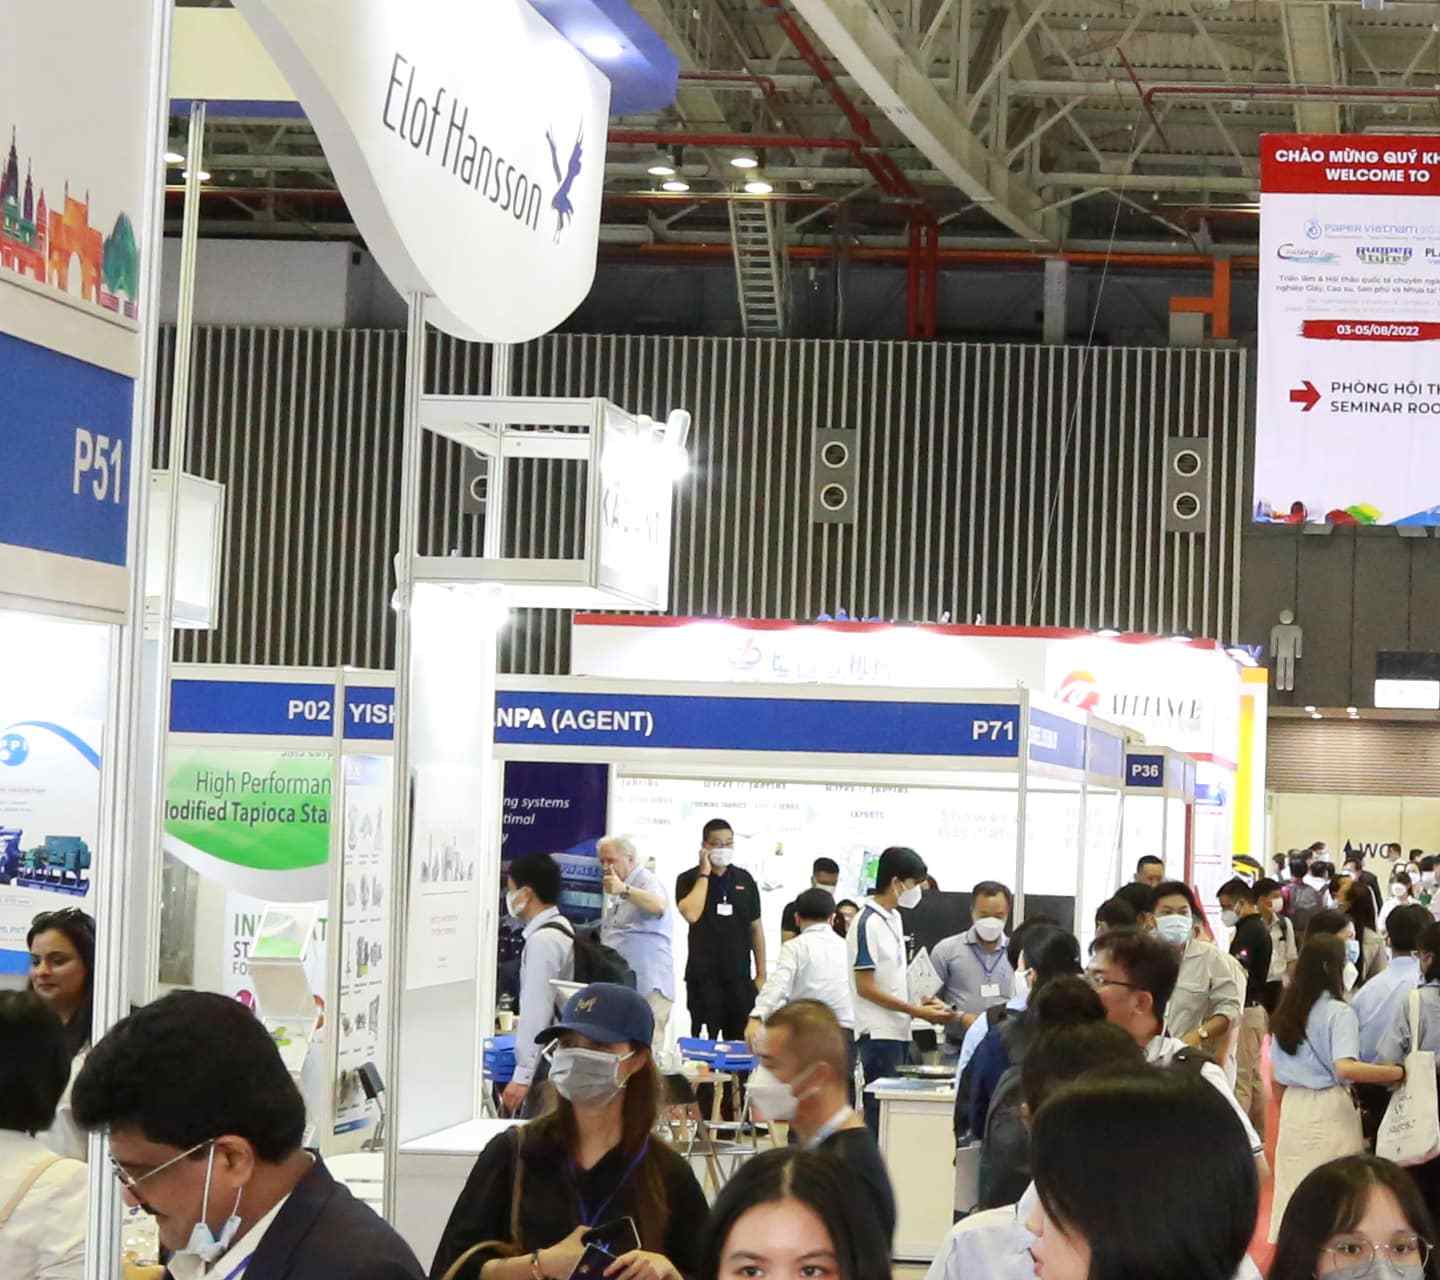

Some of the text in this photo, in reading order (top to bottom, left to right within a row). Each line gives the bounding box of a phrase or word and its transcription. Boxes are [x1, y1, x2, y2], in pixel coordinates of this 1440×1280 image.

[382, 53, 542, 232] Elof Hansson
[1326, 169, 1429, 183] WELCOME TO
[1337, 324, 1419, 337] 03-05/08/2022
[1331, 400, 1402, 414] SEMINAR
[71, 424, 125, 506] P51
[288, 700, 330, 720] P02
[552, 709, 654, 736] (AGENT)
[973, 721, 1014, 740] P71
[1132, 765, 1159, 777] P36
[196, 771, 236, 799] High
[521, 798, 570, 809] systems
[232, 802, 295, 827] Tapioca
